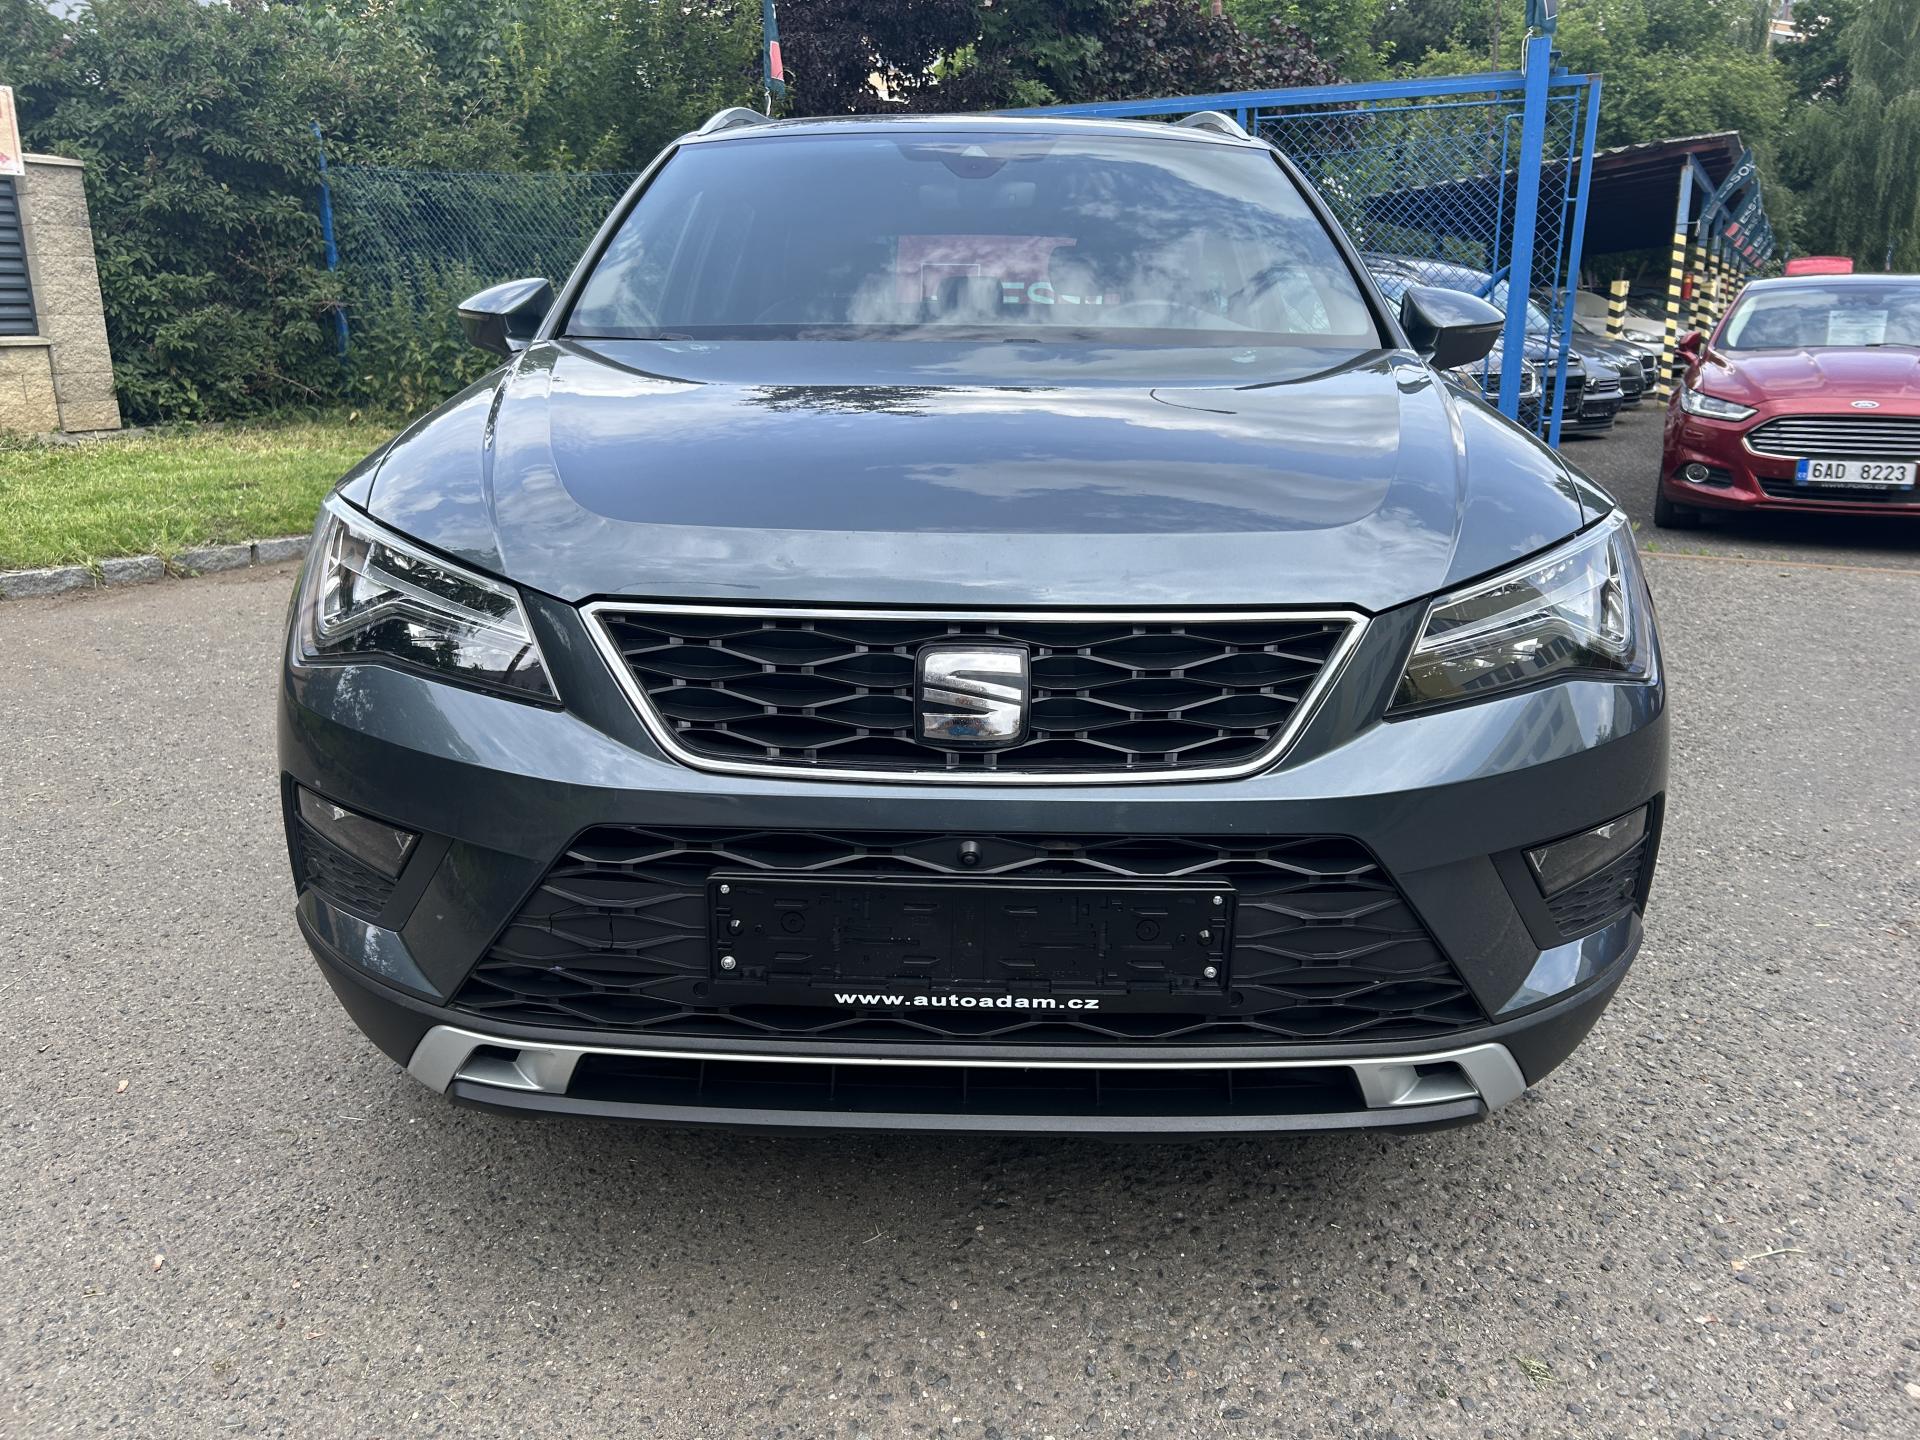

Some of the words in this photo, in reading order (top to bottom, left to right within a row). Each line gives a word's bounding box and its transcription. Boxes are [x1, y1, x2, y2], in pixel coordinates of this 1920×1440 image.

[1812, 463, 1846, 479] 6AD
[1860, 465, 1907, 481] 8223
[834, 993, 1100, 1009] www.autoadam.cz
